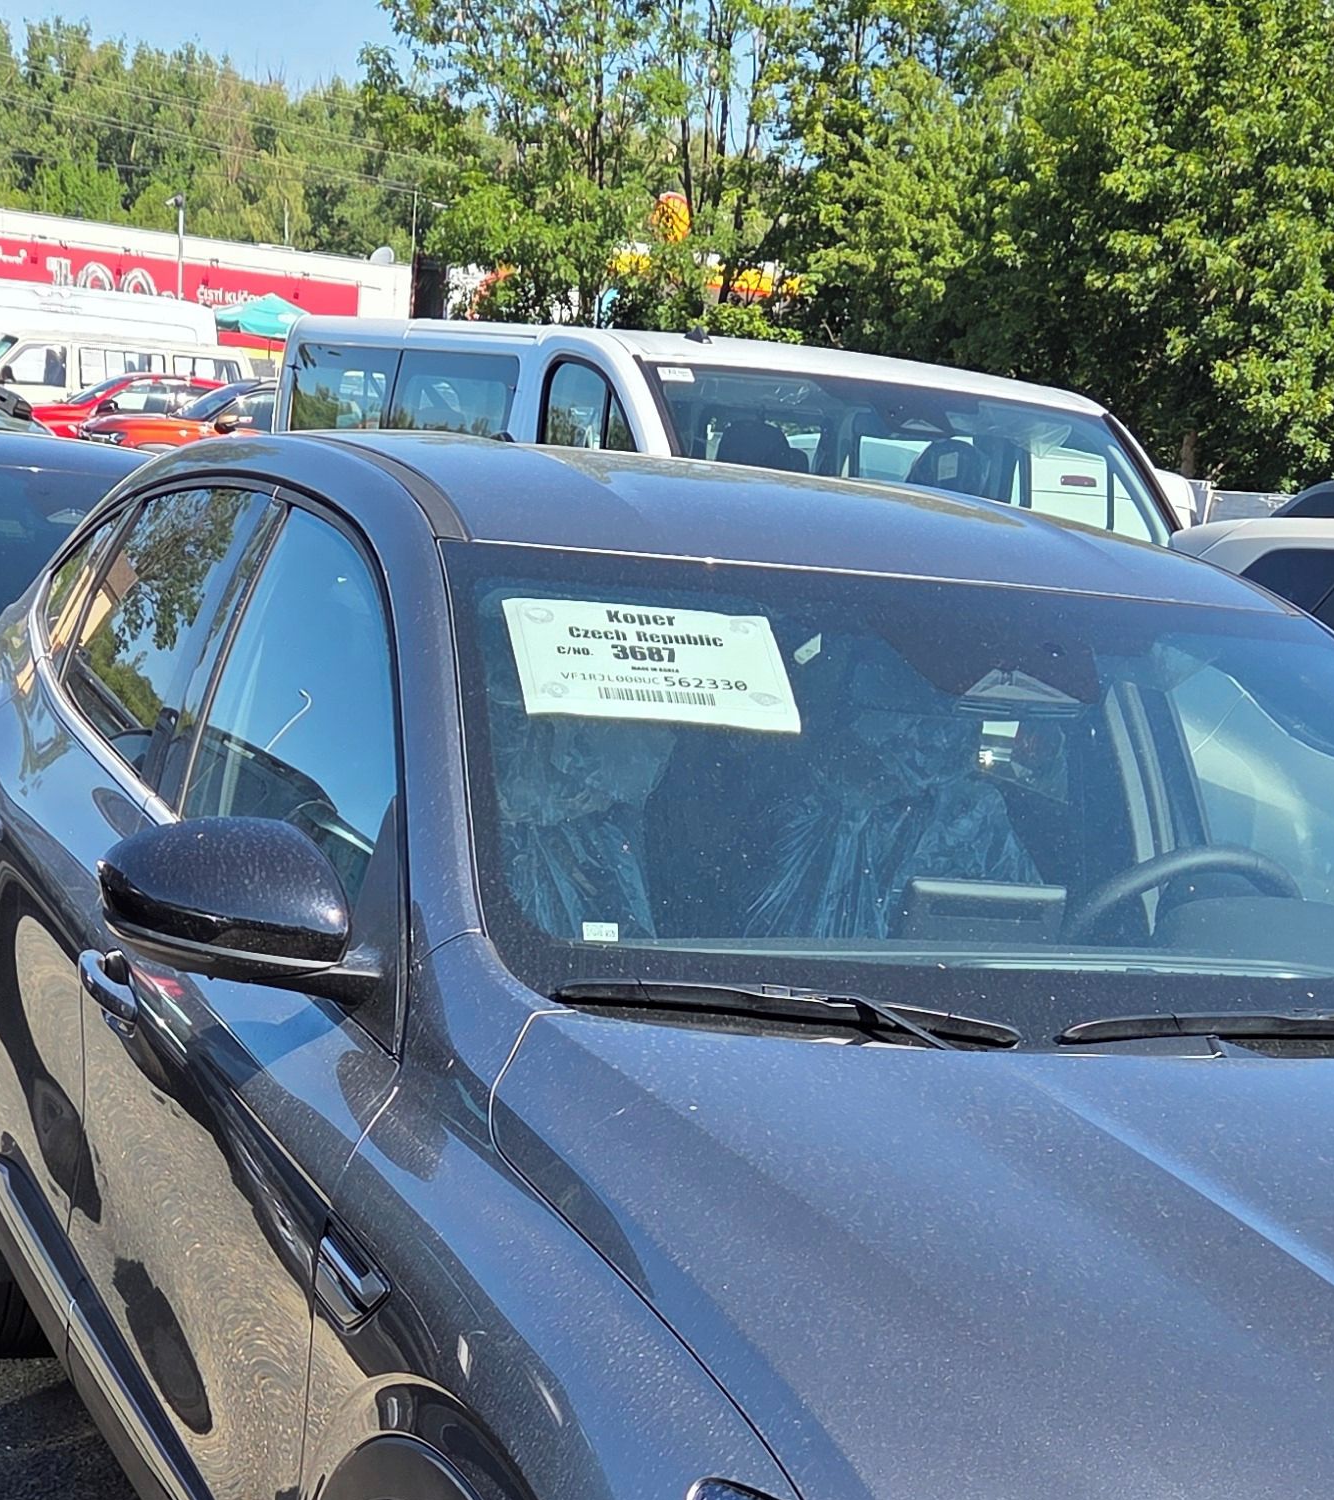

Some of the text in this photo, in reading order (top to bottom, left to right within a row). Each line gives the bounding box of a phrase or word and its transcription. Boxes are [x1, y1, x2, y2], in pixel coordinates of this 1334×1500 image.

[606, 610, 675, 626] Koper
[568, 626, 723, 647] Czech Republic
[611, 644, 675, 663] 3687
[663, 676, 748, 691] 562330
